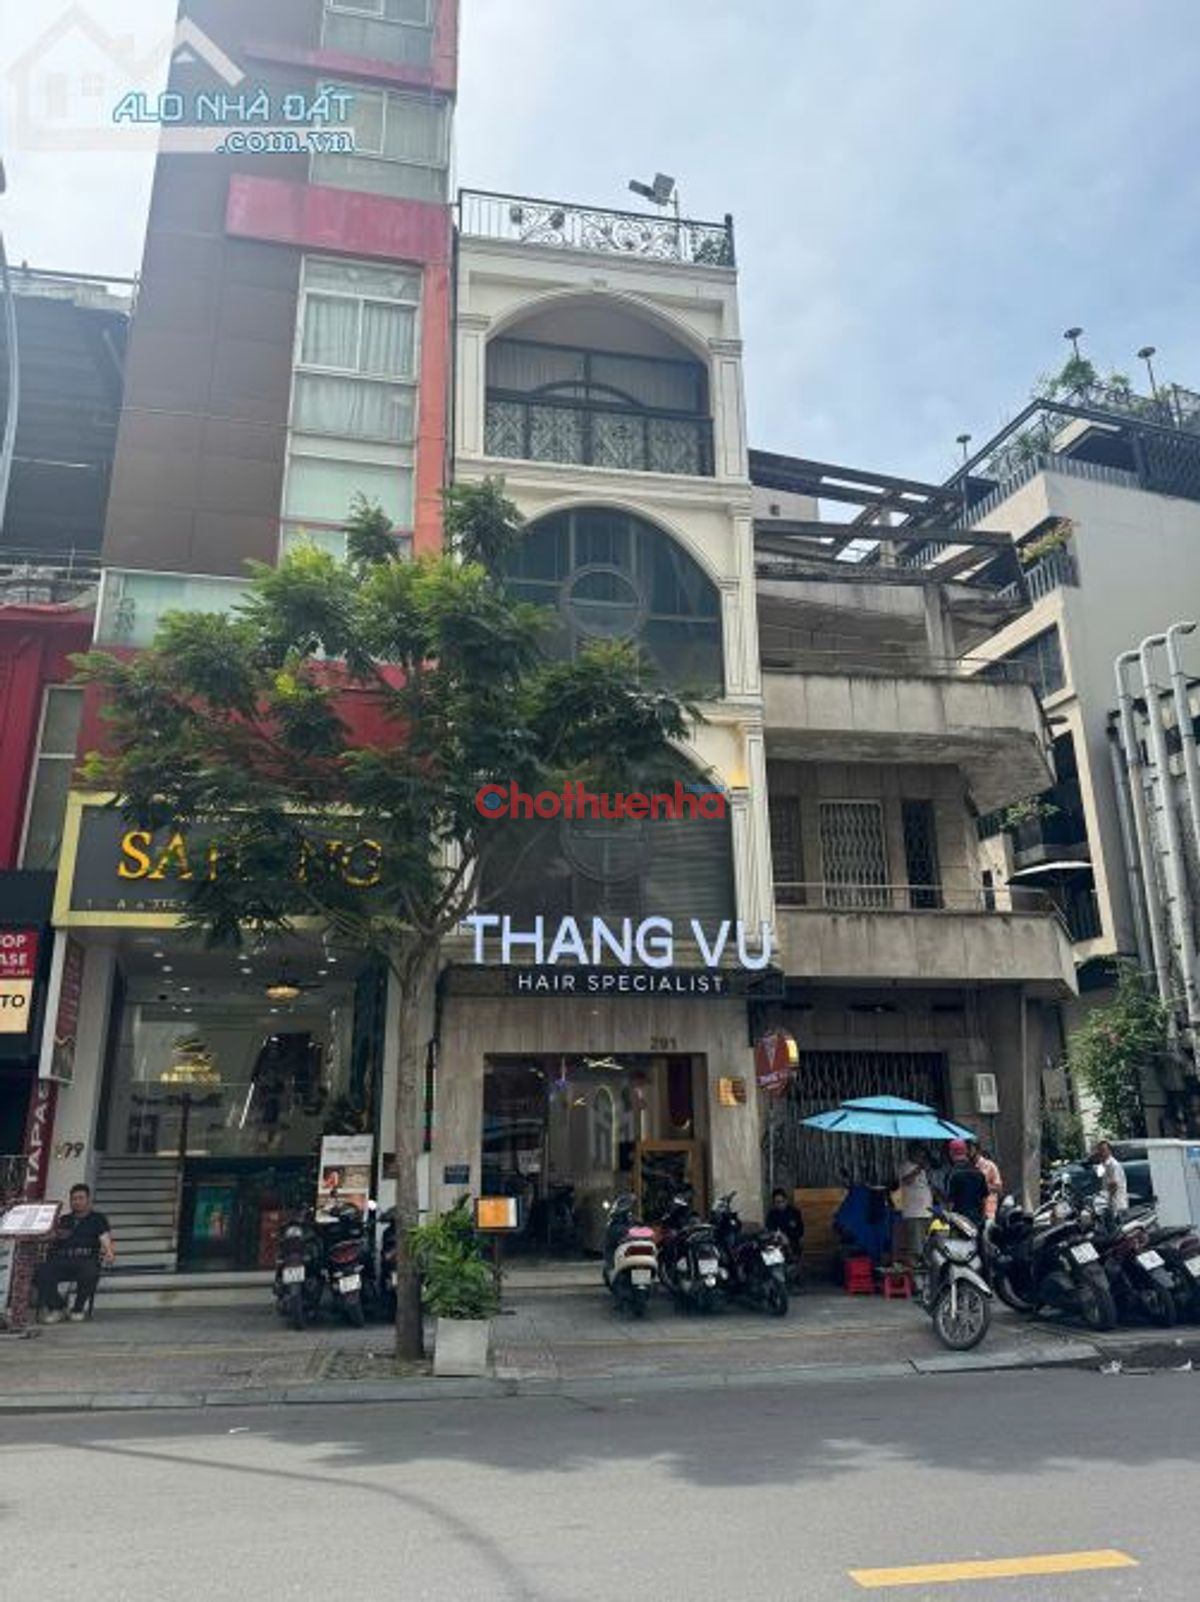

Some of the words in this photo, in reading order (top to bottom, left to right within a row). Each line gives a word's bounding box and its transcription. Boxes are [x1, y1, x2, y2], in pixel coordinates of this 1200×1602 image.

[0, 933, 26, 949] OP
[461, 914, 675, 968] THANG
[690, 918, 773, 971] VU
[517, 974, 577, 992] HAIR
[587, 974, 725, 993] SPECIALIST
